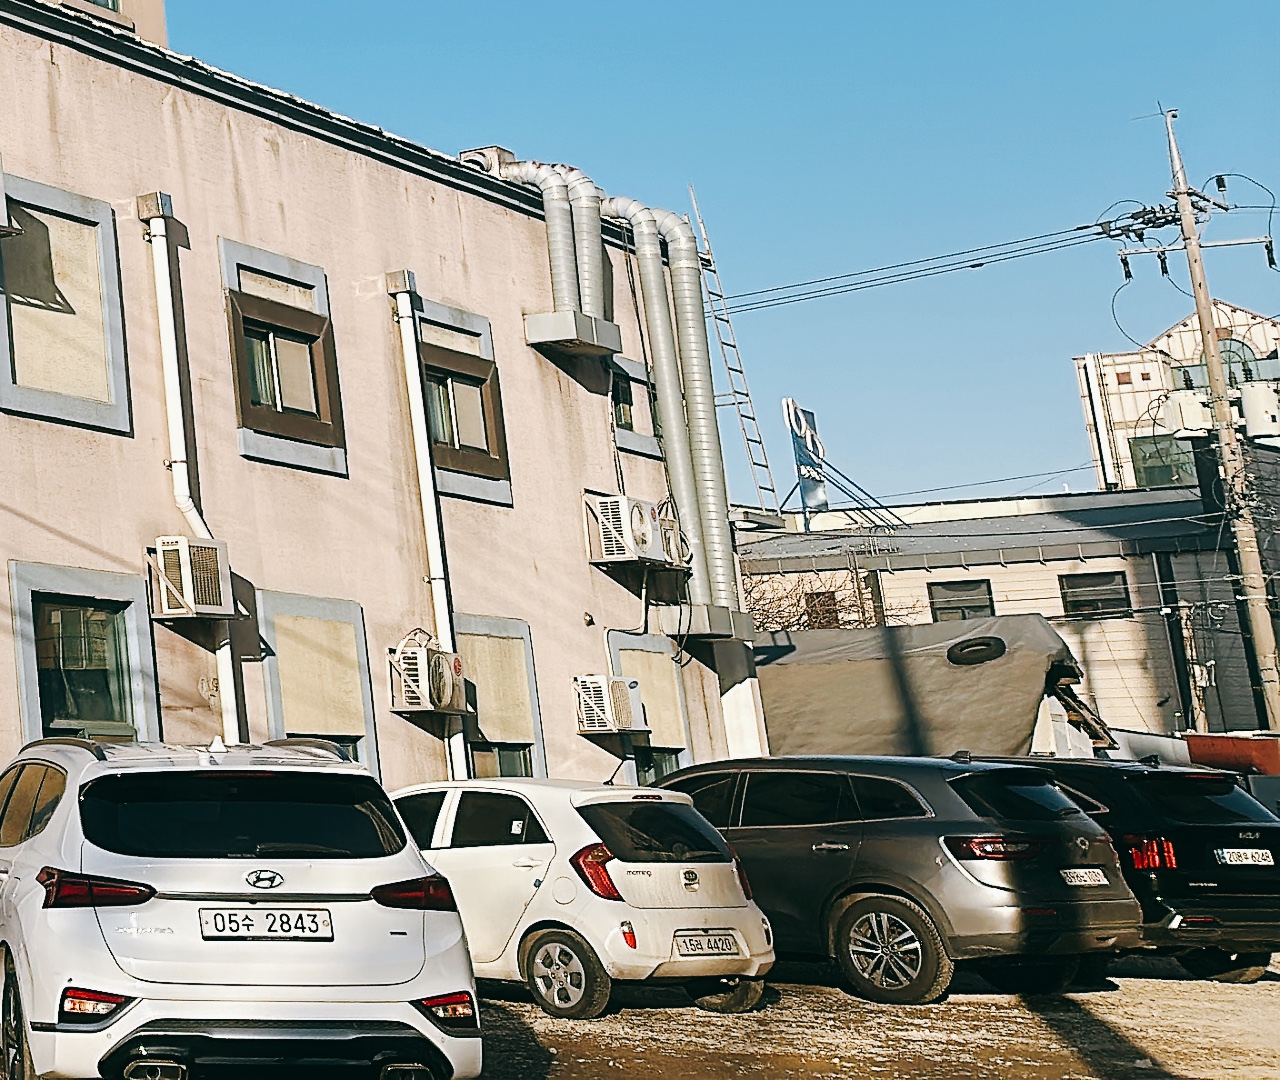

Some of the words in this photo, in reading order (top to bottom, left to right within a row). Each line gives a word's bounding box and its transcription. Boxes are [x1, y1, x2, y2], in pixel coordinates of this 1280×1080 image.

[214, 913, 255, 932] 05수
[265, 913, 320, 933] 2843
[706, 937, 732, 951] 4420
